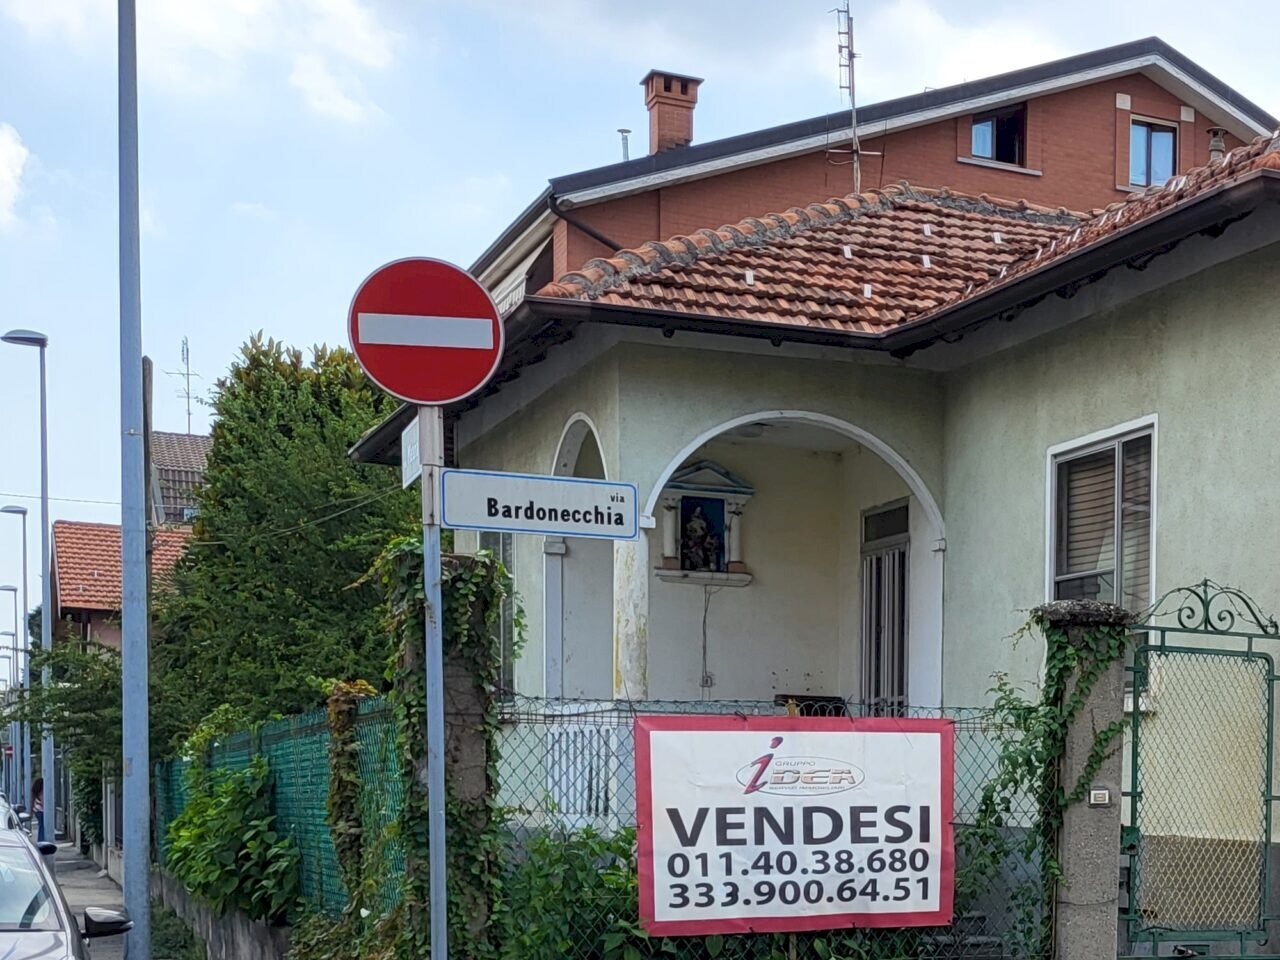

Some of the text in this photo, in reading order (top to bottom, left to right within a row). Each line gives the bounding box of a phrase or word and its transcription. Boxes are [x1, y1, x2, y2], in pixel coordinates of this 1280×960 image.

[487, 497, 624, 526] Bardonecchia
[610, 493, 625, 503] via
[666, 805, 930, 847] VENDESI
[667, 848, 930, 878] 011.40.38.680
[669, 877, 930, 909] 333.900.64.51
